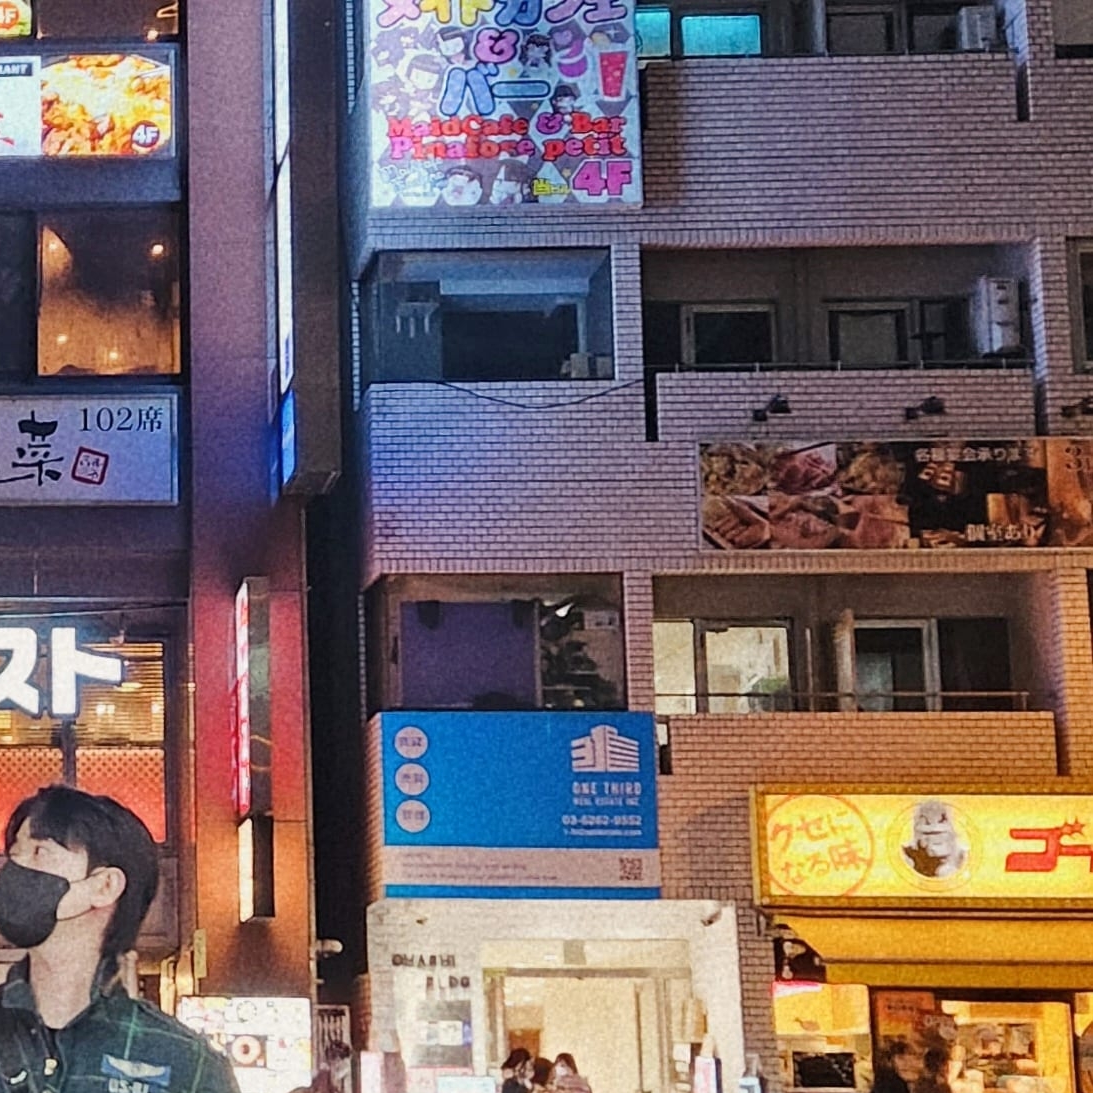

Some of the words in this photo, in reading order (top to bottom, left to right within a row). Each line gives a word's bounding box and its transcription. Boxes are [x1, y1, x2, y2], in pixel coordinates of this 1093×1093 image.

[439, 63, 551, 116] バー
[132, 124, 159, 144] 4F
[571, 112, 626, 134] Bar
[390, 137, 536, 159] Pinafore
[542, 134, 627, 160] petit
[572, 161, 633, 196] 4F
[78, 406, 163, 433] 102席
[572, 782, 597, 796] ONE
[603, 782, 642, 796] THIRD
[770, 810, 853, 853] クセに
[1005, 818, 1093, 873] ゴー
[780, 840, 867, 885] なる味
